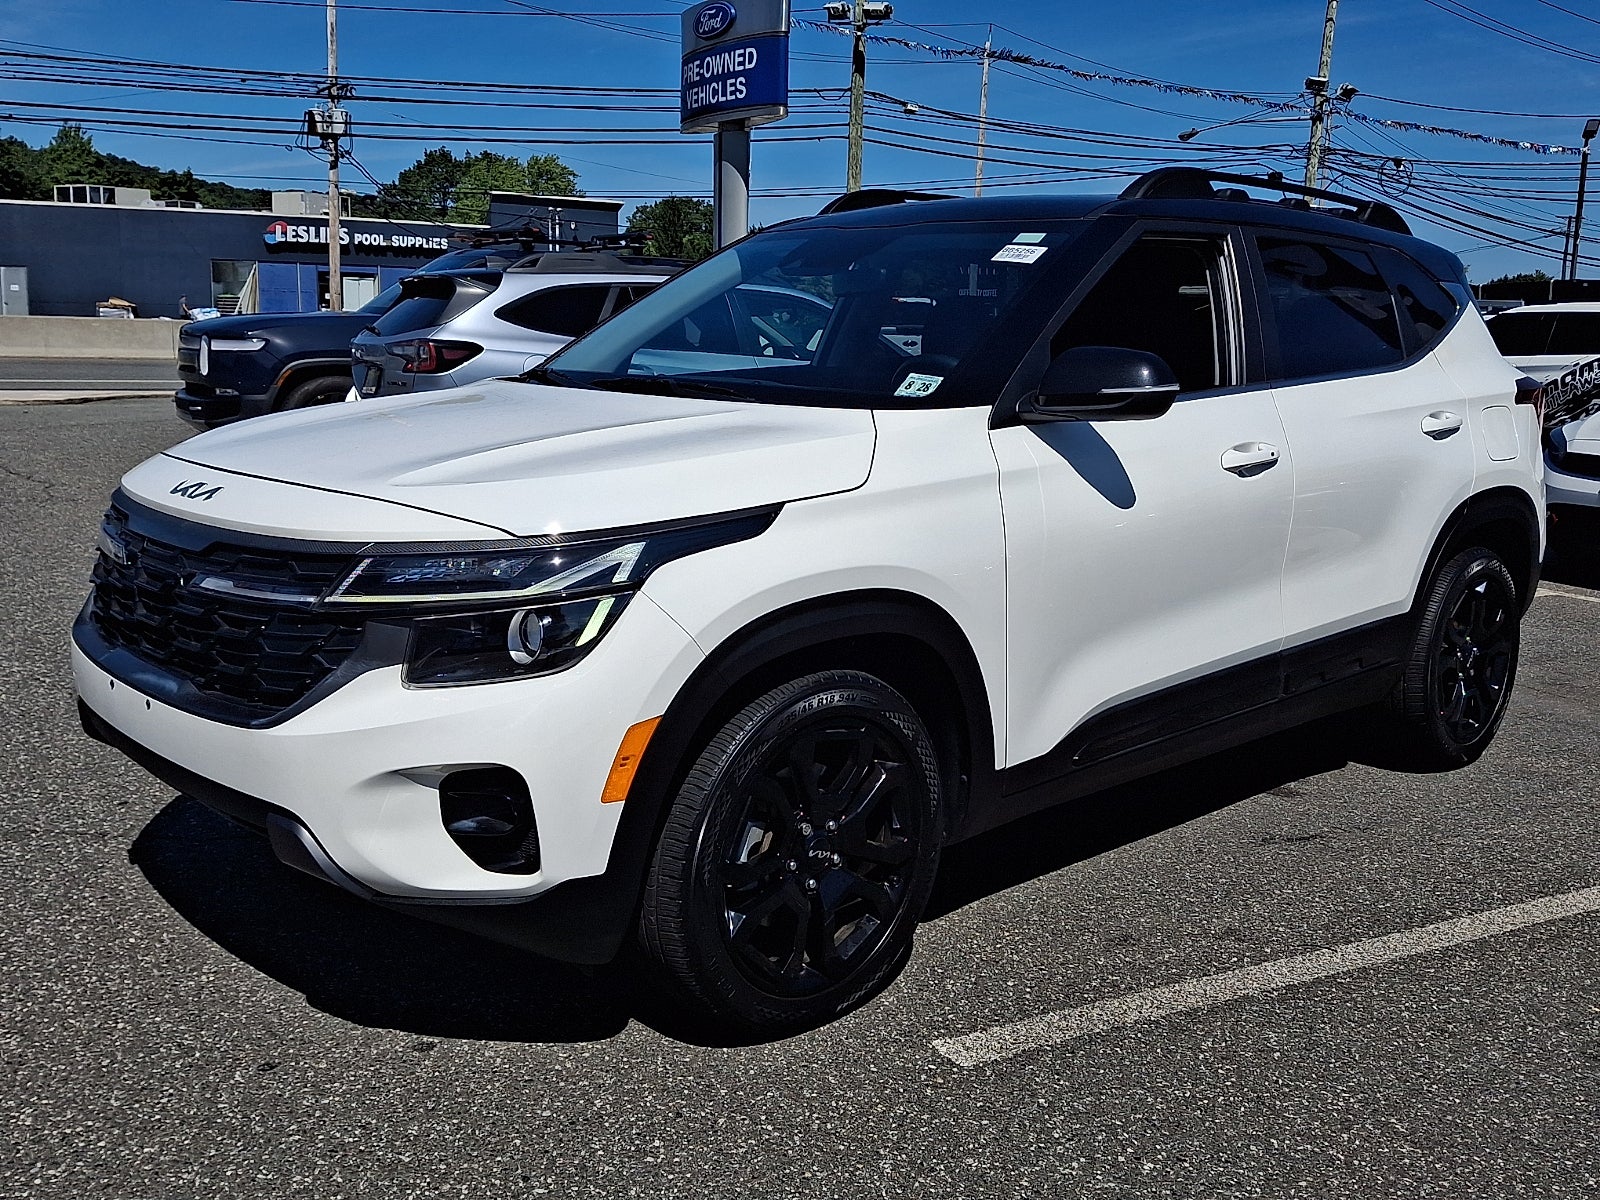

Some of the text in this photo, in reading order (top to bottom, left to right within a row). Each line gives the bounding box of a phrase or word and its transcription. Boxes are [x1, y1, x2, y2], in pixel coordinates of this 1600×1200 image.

[698, 9, 722, 33] Ford
[683, 48, 757, 86] PRE-OWNED
[686, 77, 747, 109] VEHICLES
[354, 233, 386, 246] POOL
[904, 380, 932, 392] 8 28
[169, 479, 224, 501] KIA
[816, 694, 835, 707] R18
[837, 693, 859, 703] 94V
